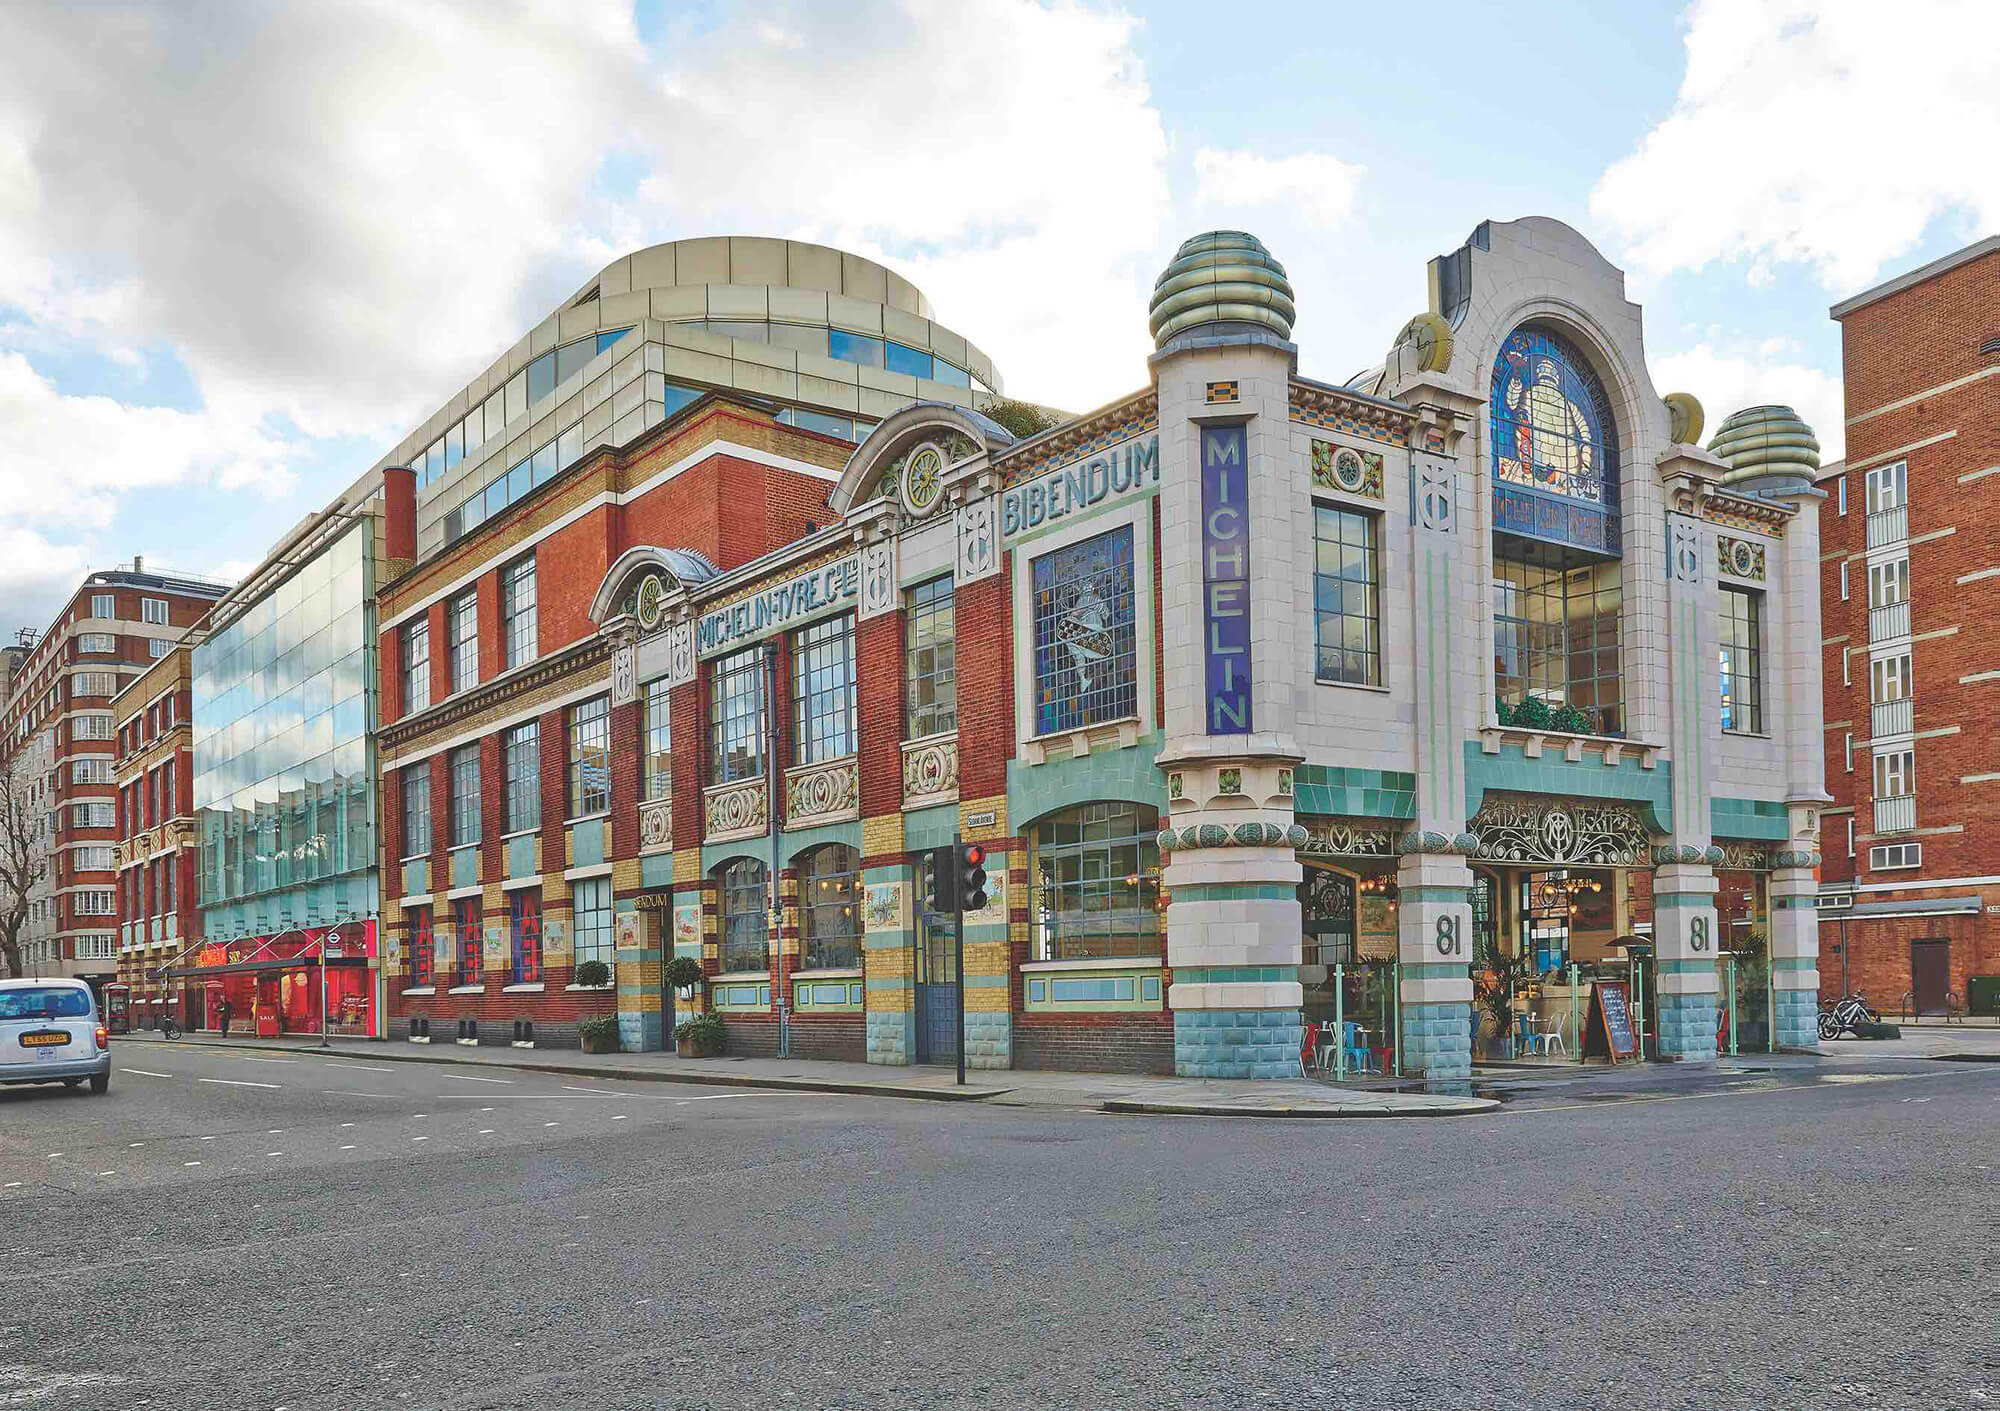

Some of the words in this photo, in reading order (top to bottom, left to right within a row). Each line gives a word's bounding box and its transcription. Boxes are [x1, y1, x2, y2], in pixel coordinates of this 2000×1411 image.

[1003, 434, 1160, 537] BIBENDUM
[1207, 434, 1246, 729] MICHELIN
[696, 592, 772, 652] MICHELIN
[1436, 915, 1461, 955] 81
[1691, 916, 1709, 952] 81
